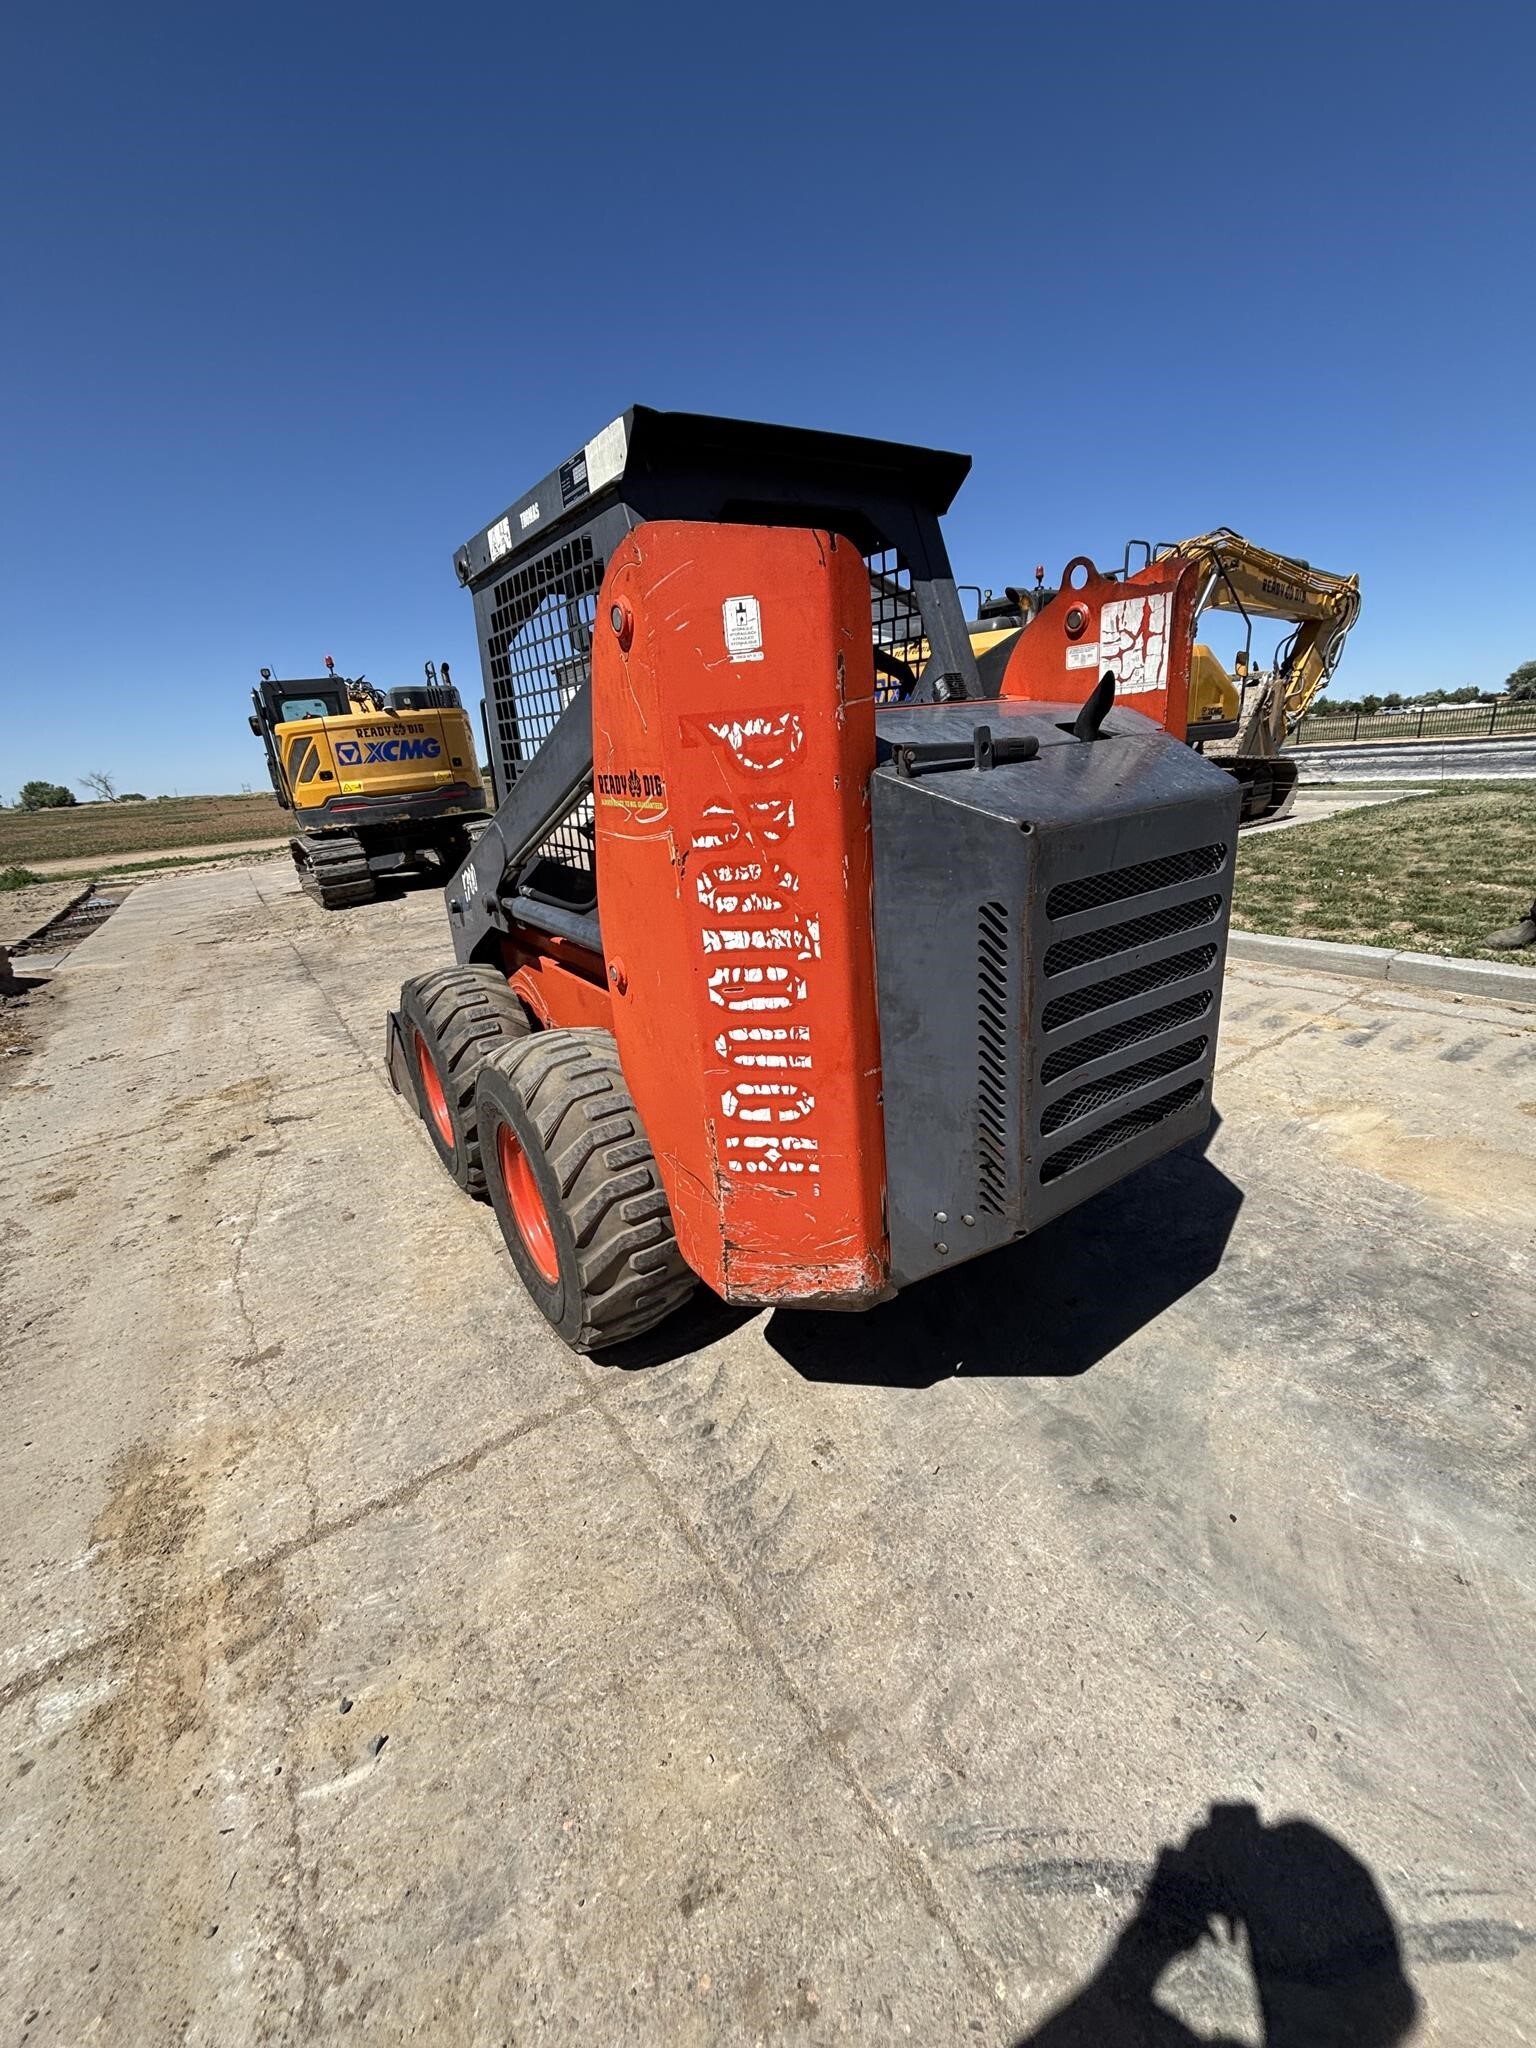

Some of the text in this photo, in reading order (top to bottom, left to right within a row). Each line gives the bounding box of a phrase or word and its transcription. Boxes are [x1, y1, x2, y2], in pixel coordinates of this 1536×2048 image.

[356, 723, 425, 738] READY DIG
[363, 738, 441, 764] XCMG
[597, 774, 662, 796] READY DIG
[678, 706, 821, 1174] PROTOUGH
